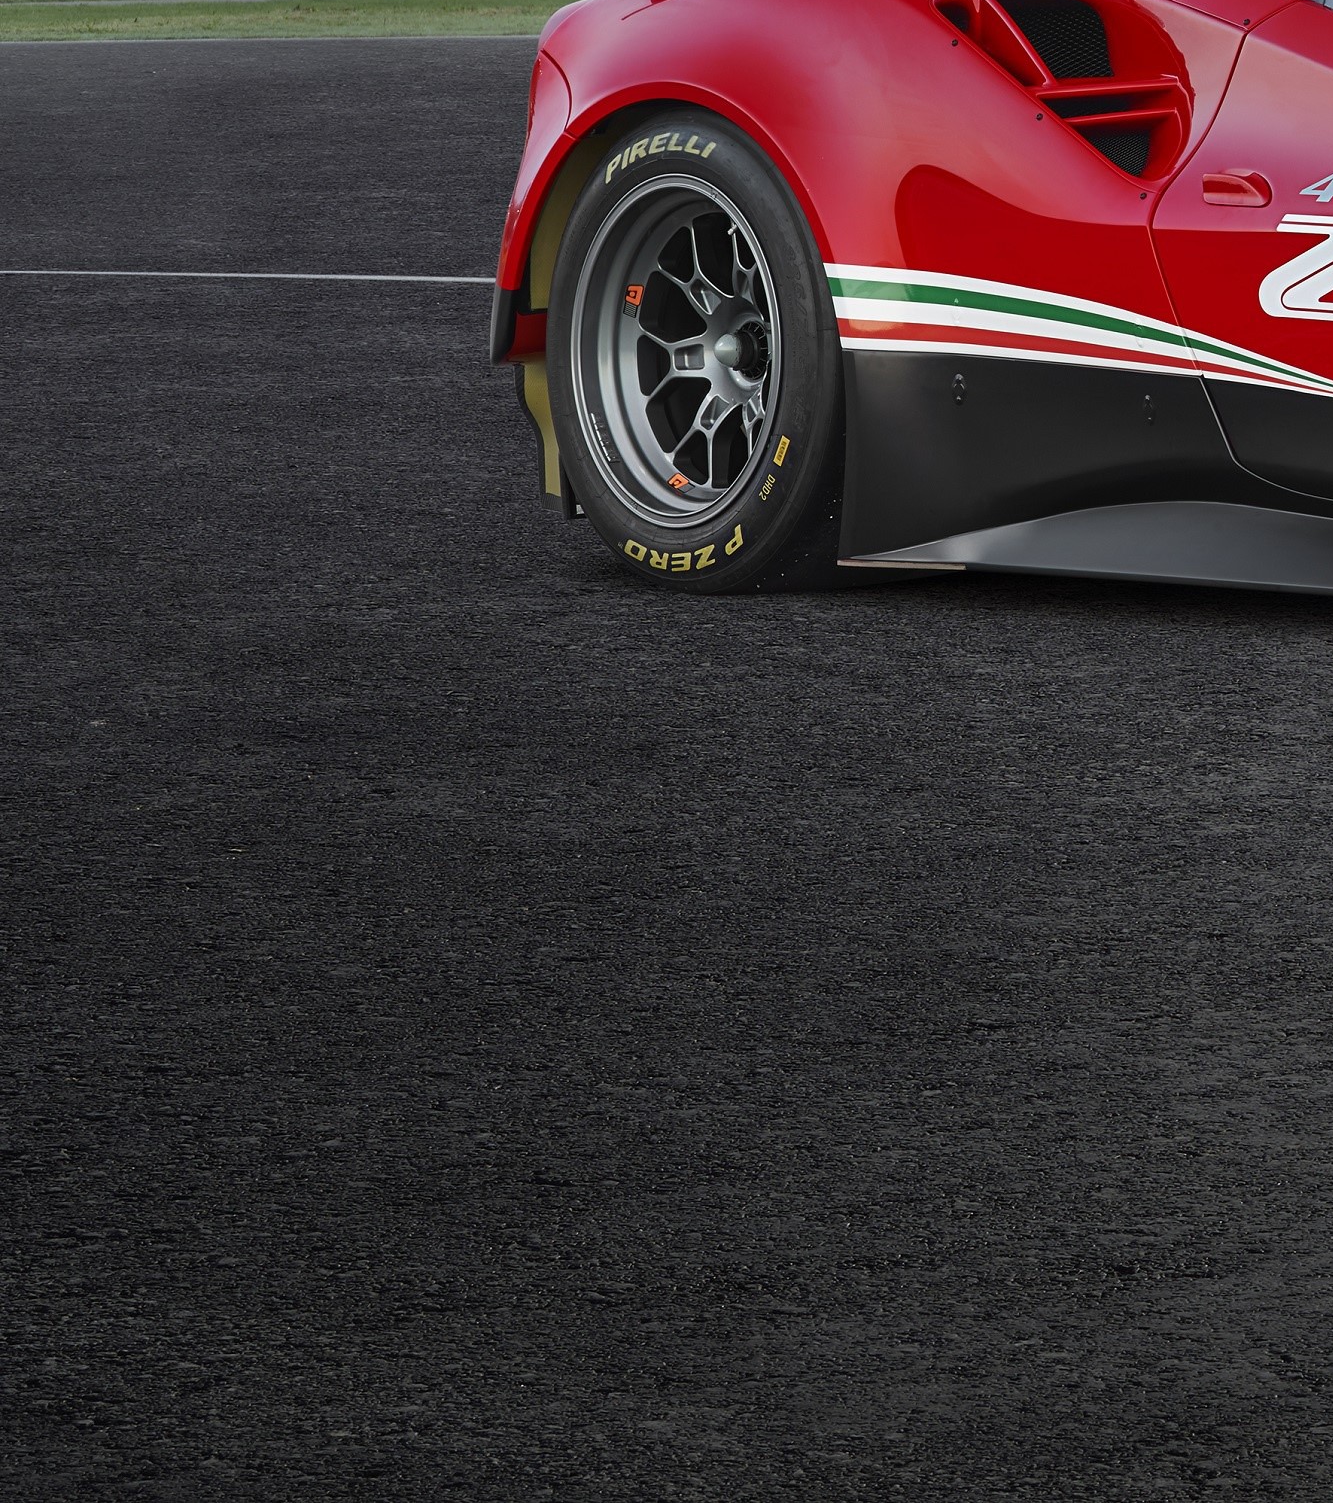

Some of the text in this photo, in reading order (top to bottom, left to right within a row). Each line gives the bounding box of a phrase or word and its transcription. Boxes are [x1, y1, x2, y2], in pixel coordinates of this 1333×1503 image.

[605, 132, 717, 185] PIRELLI
[758, 473, 776, 501] DHD2
[623, 523, 744, 573] P ZERO
